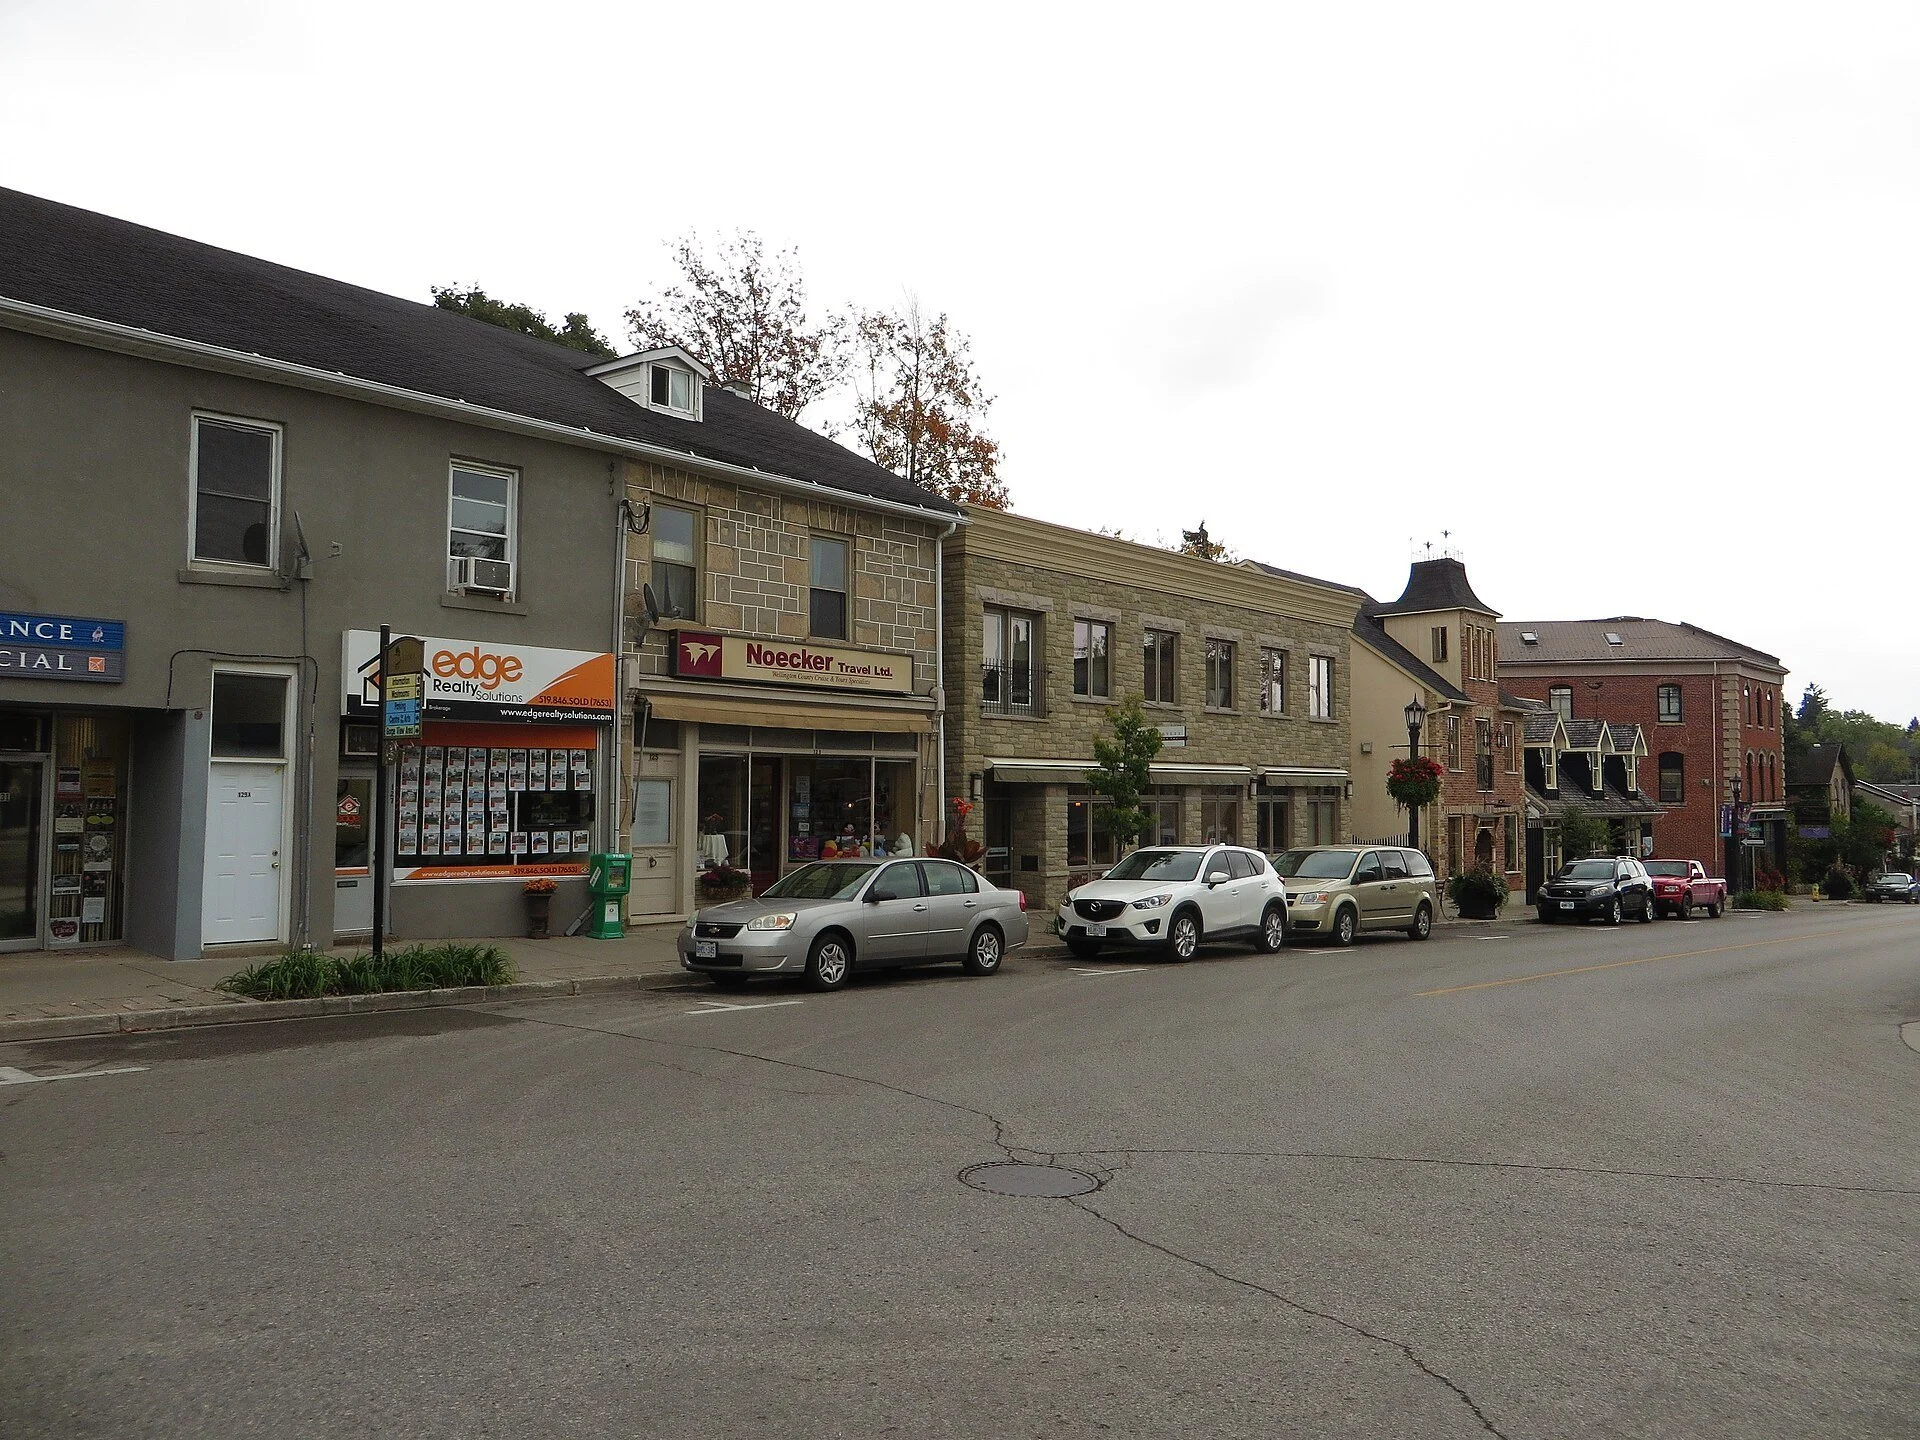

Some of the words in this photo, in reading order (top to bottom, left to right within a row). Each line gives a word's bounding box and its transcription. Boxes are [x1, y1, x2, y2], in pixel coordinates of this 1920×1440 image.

[0, 620, 73, 640] NCE
[0, 651, 72, 671] CIAL
[747, 643, 833, 670] Noecker
[837, 662, 871, 676] Travel
[874, 665, 893, 677] Ltd.
[432, 646, 524, 690] edge
[772, 671, 797, 680] Wellington
[797, 673, 814, 681] County
[433, 679, 479, 696] Realty
[476, 690, 523, 703] Solutions
[539, 695, 590, 707] 519.846.SOLD
[590, 697, 612, 708] (7653)
[500, 708, 612, 722] www.edgerealtysolutions.com
[513, 866, 557, 875] 519.846.SOLD
[558, 866, 578, 874] (7653)
